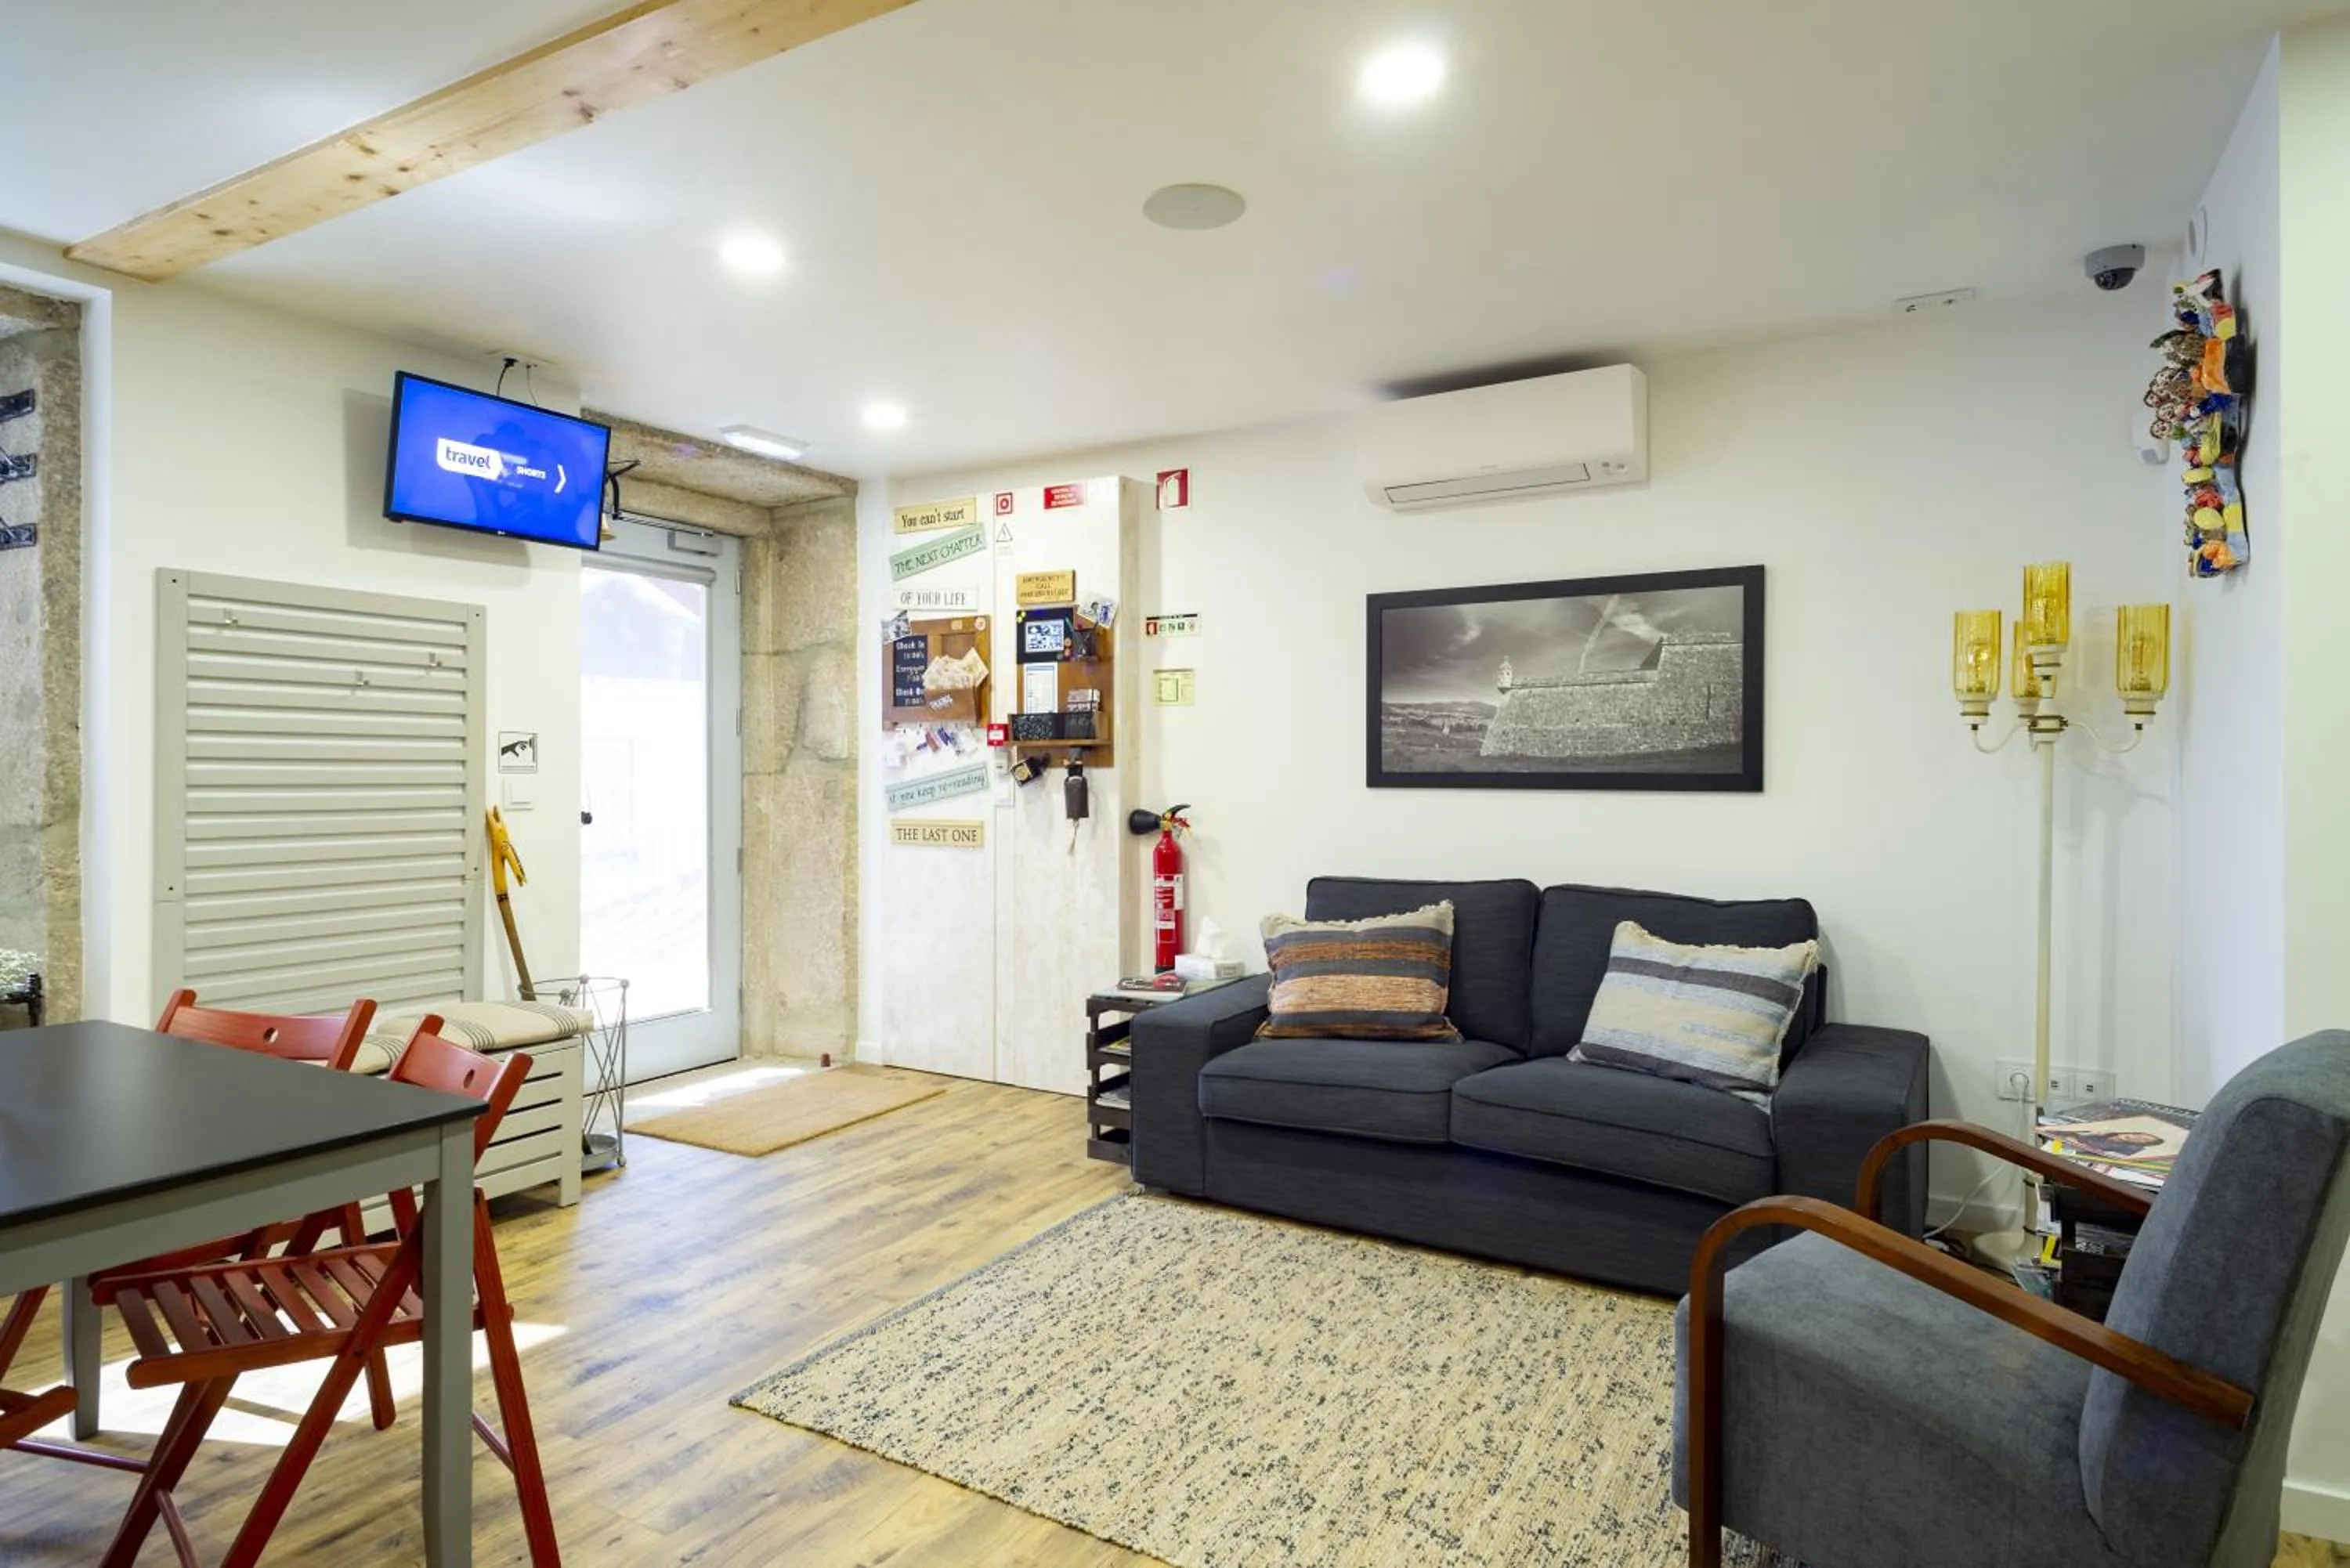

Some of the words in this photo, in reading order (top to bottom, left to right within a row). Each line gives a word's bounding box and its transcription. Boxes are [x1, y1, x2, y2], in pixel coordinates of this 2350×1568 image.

[446, 446, 491, 469] travel
[902, 515, 917, 528] You
[920, 508, 941, 526] can't
[943, 508, 964, 522] start
[895, 558, 913, 573] THE
[916, 549, 938, 567] NEXT
[940, 533, 983, 558] CHAPTER
[900, 591, 913, 605] OF
[916, 591, 941, 605] YOUR
[944, 591, 966, 605] LIFE
[896, 828, 918, 840] THE
[922, 828, 949, 842] LAST
[952, 828, 978, 843] ONE
